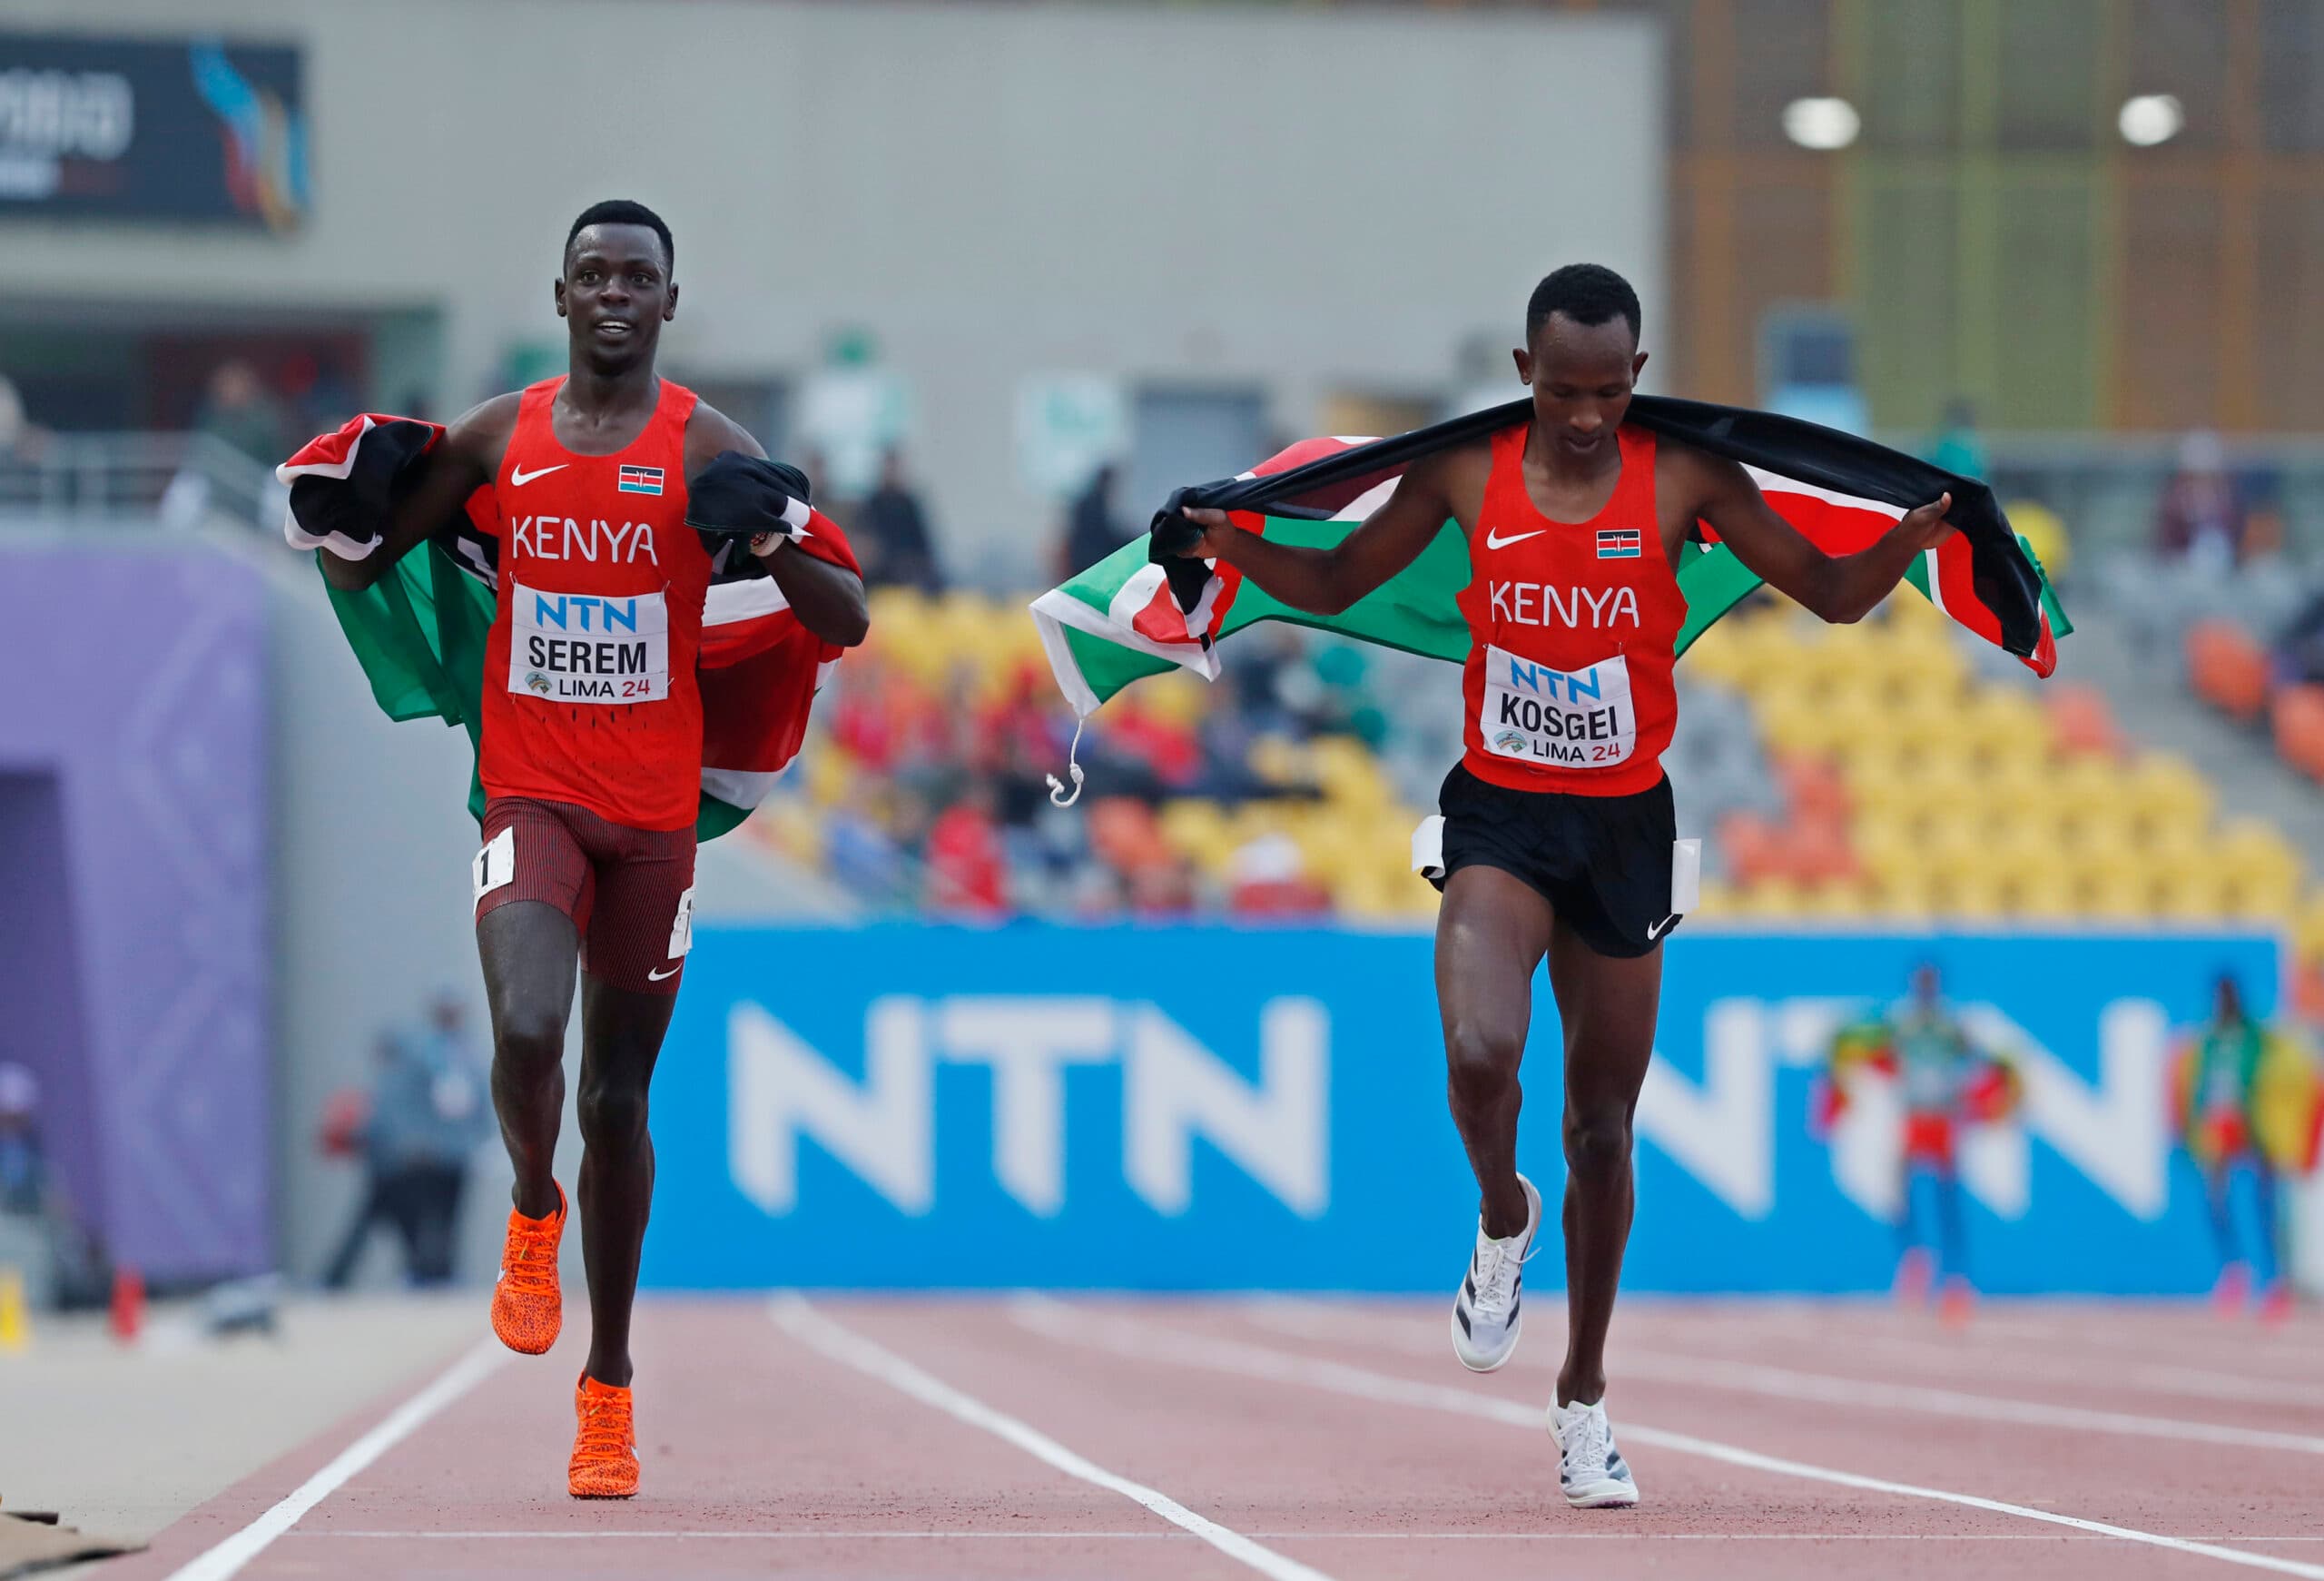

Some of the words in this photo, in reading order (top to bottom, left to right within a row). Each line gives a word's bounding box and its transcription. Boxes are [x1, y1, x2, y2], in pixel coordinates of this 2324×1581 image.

[512, 516, 658, 566] KENYA
[536, 593, 636, 633] NTN
[1490, 580, 1640, 628] KENYA
[528, 636, 647, 674] SEREM
[559, 678, 615, 697] LIMA
[622, 678, 651, 697] 24
[1510, 657, 1601, 705] NTN
[1500, 692, 1619, 741] KOSGEI
[1532, 739, 1585, 762] LIMA
[1592, 743, 1621, 762] 24
[480, 849, 490, 887] 1
[729, 995, 1333, 1219] NTN
